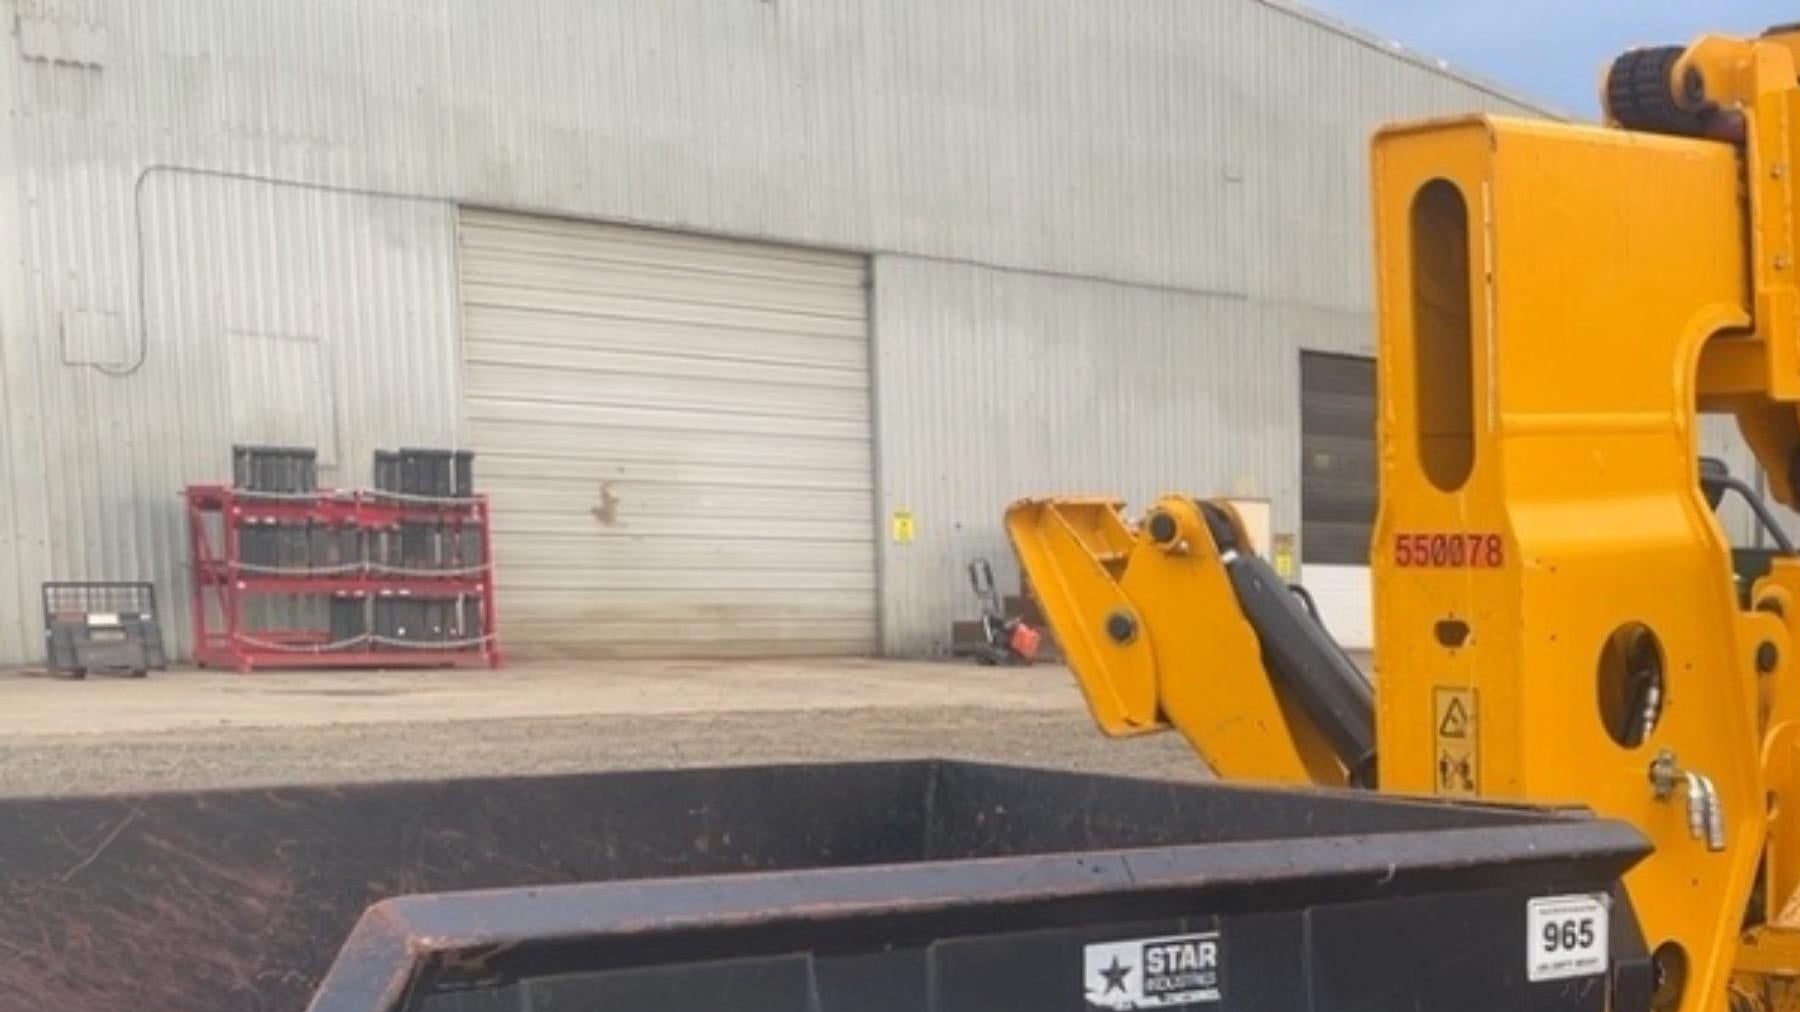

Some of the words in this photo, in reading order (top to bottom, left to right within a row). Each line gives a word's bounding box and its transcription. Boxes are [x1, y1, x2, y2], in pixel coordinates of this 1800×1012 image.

[1395, 532, 1504, 569] 550078
[1543, 917, 1595, 952] 965
[1146, 940, 1217, 975] STAR
